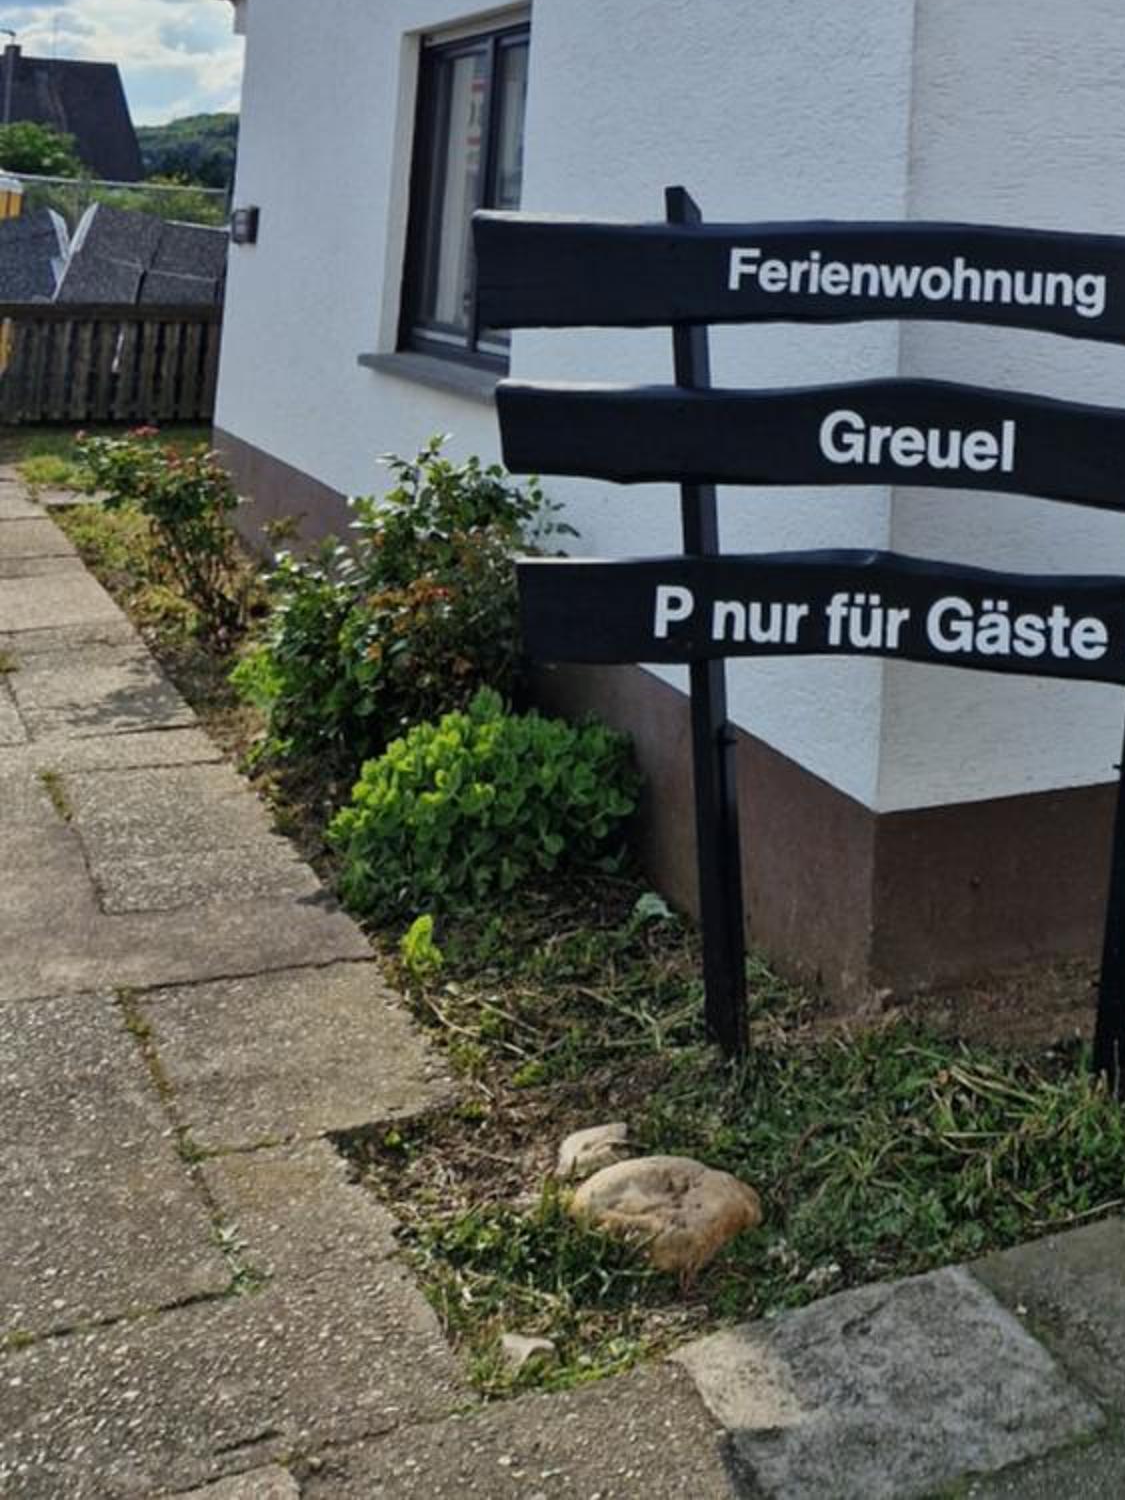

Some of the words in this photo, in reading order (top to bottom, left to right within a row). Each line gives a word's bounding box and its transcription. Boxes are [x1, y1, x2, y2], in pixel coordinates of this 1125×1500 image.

[728, 247, 1106, 318] Ferienwohnung
[819, 409, 1015, 472] Greuel
[653, 585, 694, 638] P
[712, 600, 809, 646] nur
[825, 592, 910, 649] für
[926, 596, 1108, 660] Gäste
